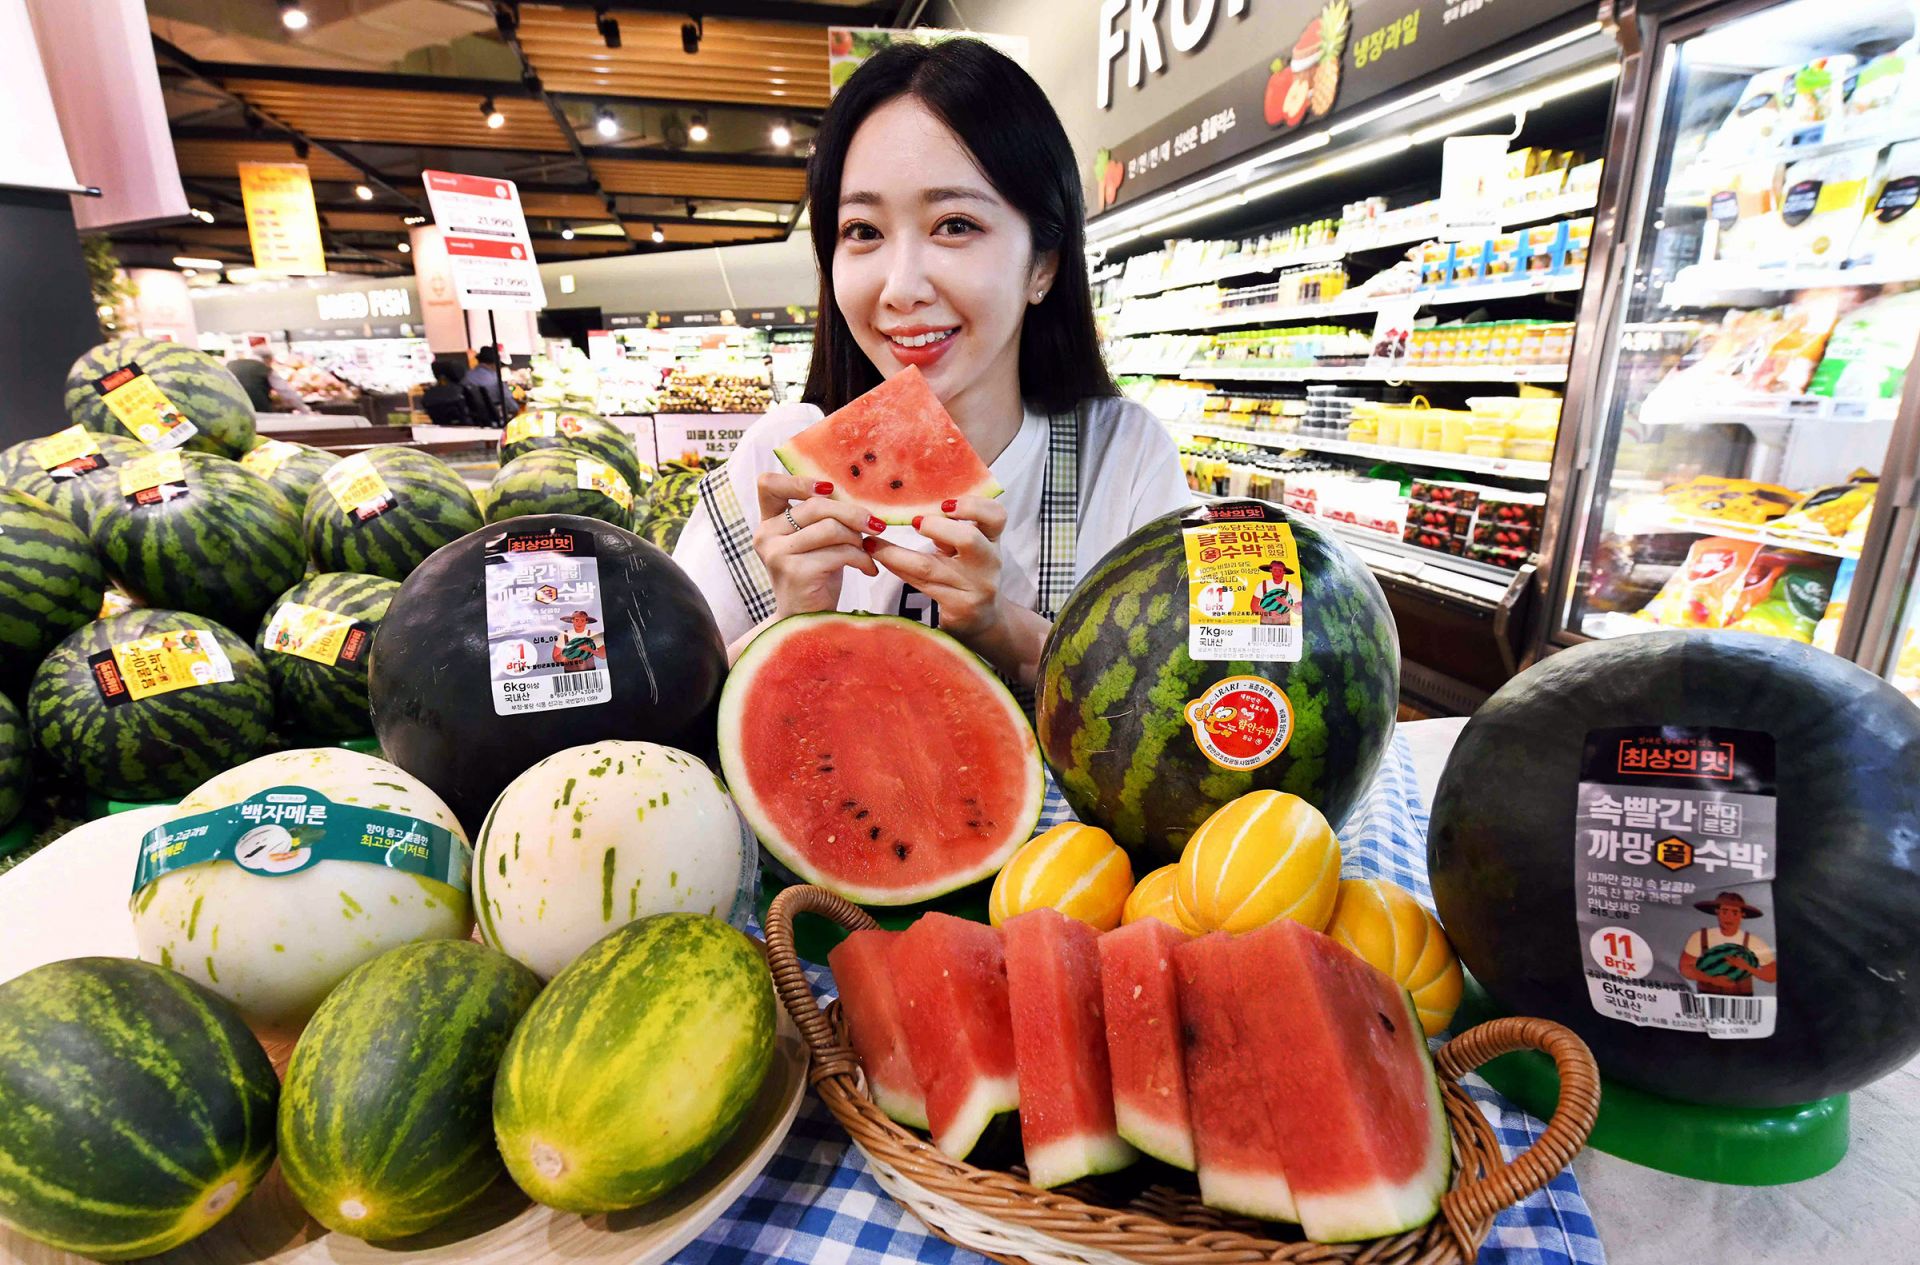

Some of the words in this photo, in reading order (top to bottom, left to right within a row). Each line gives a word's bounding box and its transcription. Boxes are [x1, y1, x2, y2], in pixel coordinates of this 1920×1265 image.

[1353, 8, 1420, 69] 냉장과일
[368, 288, 411, 317] FISH
[511, 539, 554, 552] 최상의
[555, 538, 570, 549] 맛
[1197, 531, 1281, 547] 달콤아삭
[1222, 544, 1263, 559] 수박
[1199, 637, 1223, 647] 국내산
[504, 692, 530, 703] 국내산
[1238, 719, 1275, 739] 함안수박
[1623, 747, 1697, 771] 최상의
[1701, 750, 1728, 773] 맛
[241, 803, 327, 825] 백자메론
[1589, 794, 1698, 832] 속빨간
[366, 823, 385, 836] 향이
[386, 827, 404, 839] 좋고
[360, 834, 395, 849] 최고의
[1587, 829, 1655, 866] 까망
[1663, 842, 1686, 864] 꿀
[1693, 839, 1768, 879] 수박
[1586, 872, 1620, 886] 새까만
[1621, 875, 1643, 888] 껍질
[1587, 885, 1608, 898] 가득
[1610, 887, 1621, 899] 찬
[1623, 889, 1645, 902] 빨간
[1587, 897, 1641, 914] 만나보세요
[1603, 933, 1633, 959] 11
[1604, 956, 1637, 972] Brix
[1604, 995, 1643, 1013] 국내산
